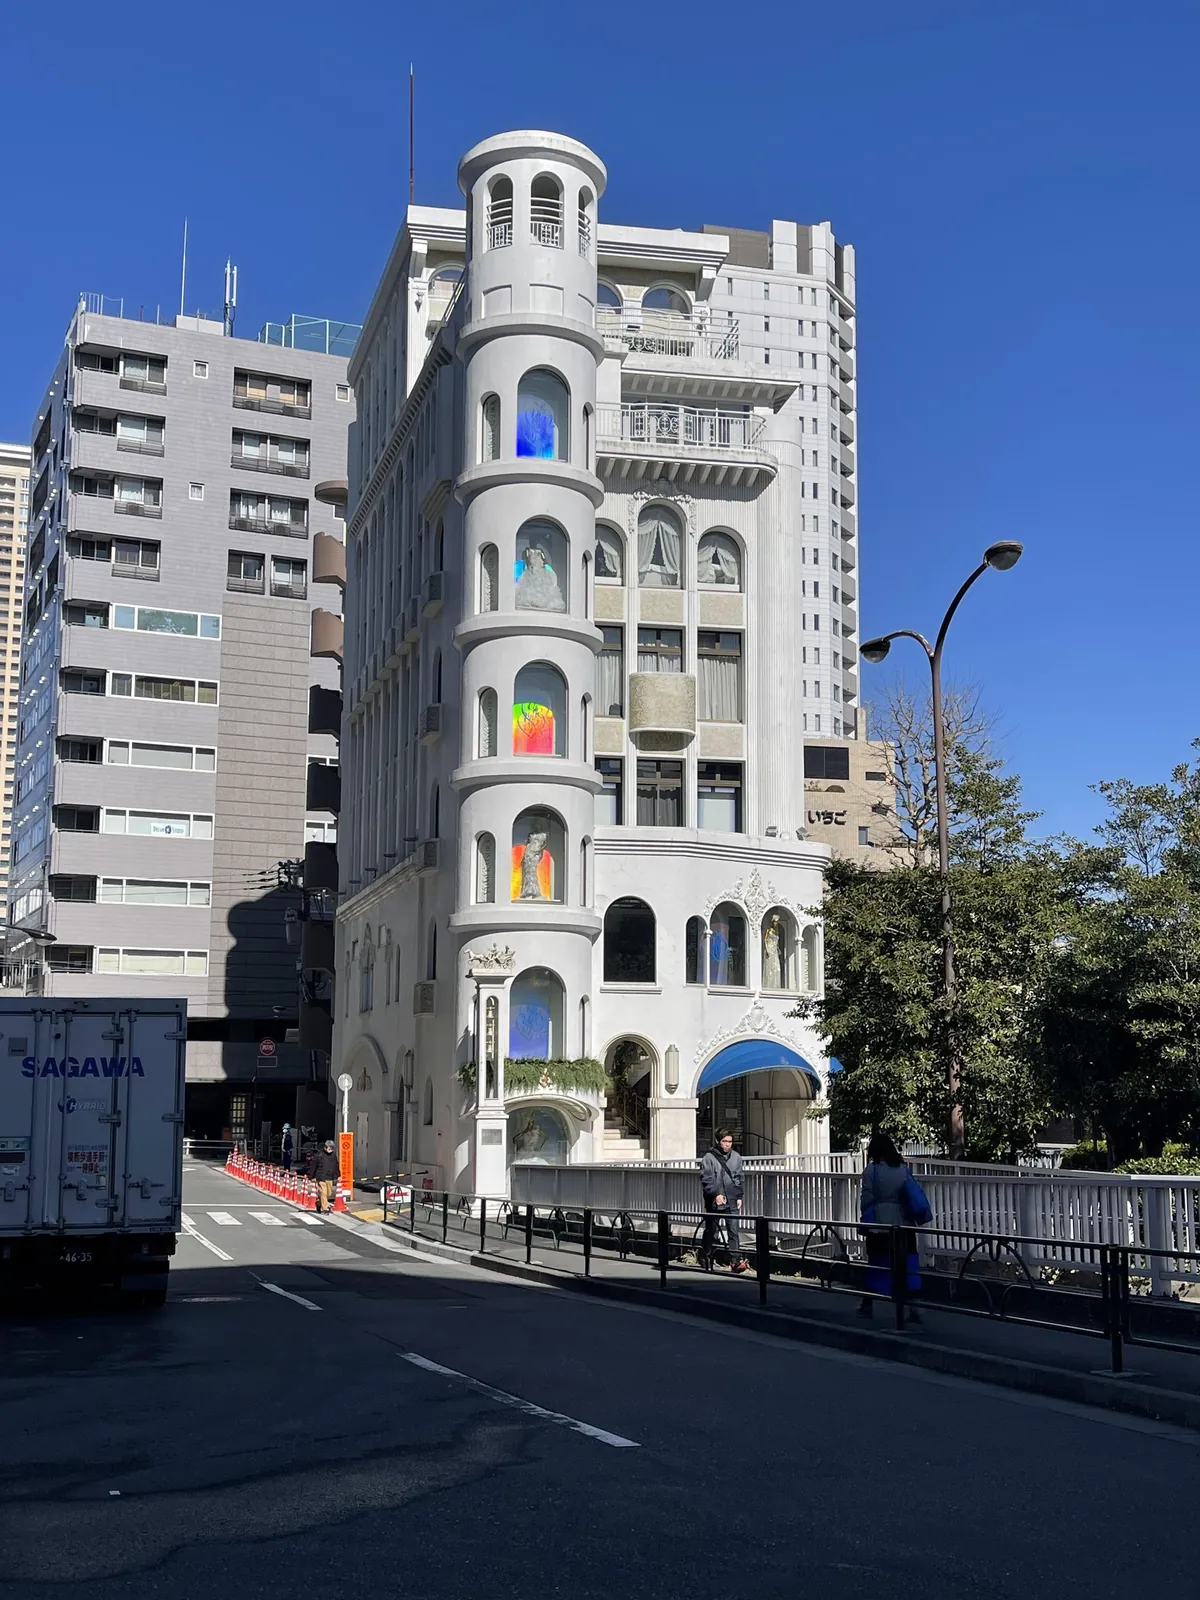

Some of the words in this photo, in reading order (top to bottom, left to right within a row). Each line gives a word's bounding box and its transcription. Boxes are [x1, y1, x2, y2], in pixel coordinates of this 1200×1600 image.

[808, 810, 847, 825] いちご
[21, 1057, 145, 1078] SAGAWA
[69, 1102, 107, 1111] HYBRID
